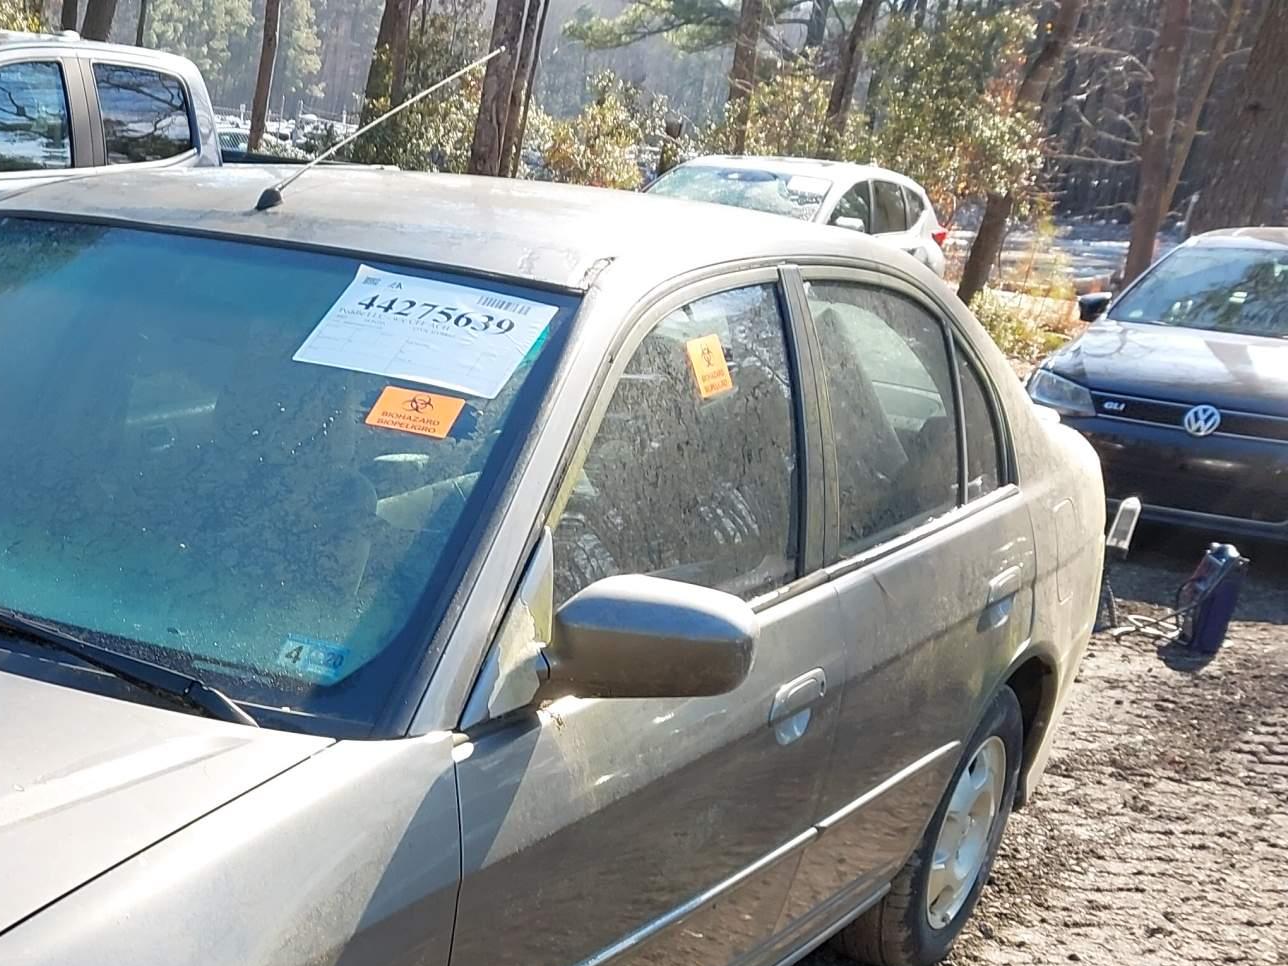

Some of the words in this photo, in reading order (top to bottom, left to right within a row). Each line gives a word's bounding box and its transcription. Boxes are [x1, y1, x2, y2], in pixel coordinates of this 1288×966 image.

[357, 293, 516, 335] 44275639
[1103, 401, 1126, 411] GLI
[381, 410, 440, 426] BIOHAZARD
[284, 645, 304, 664] 4
